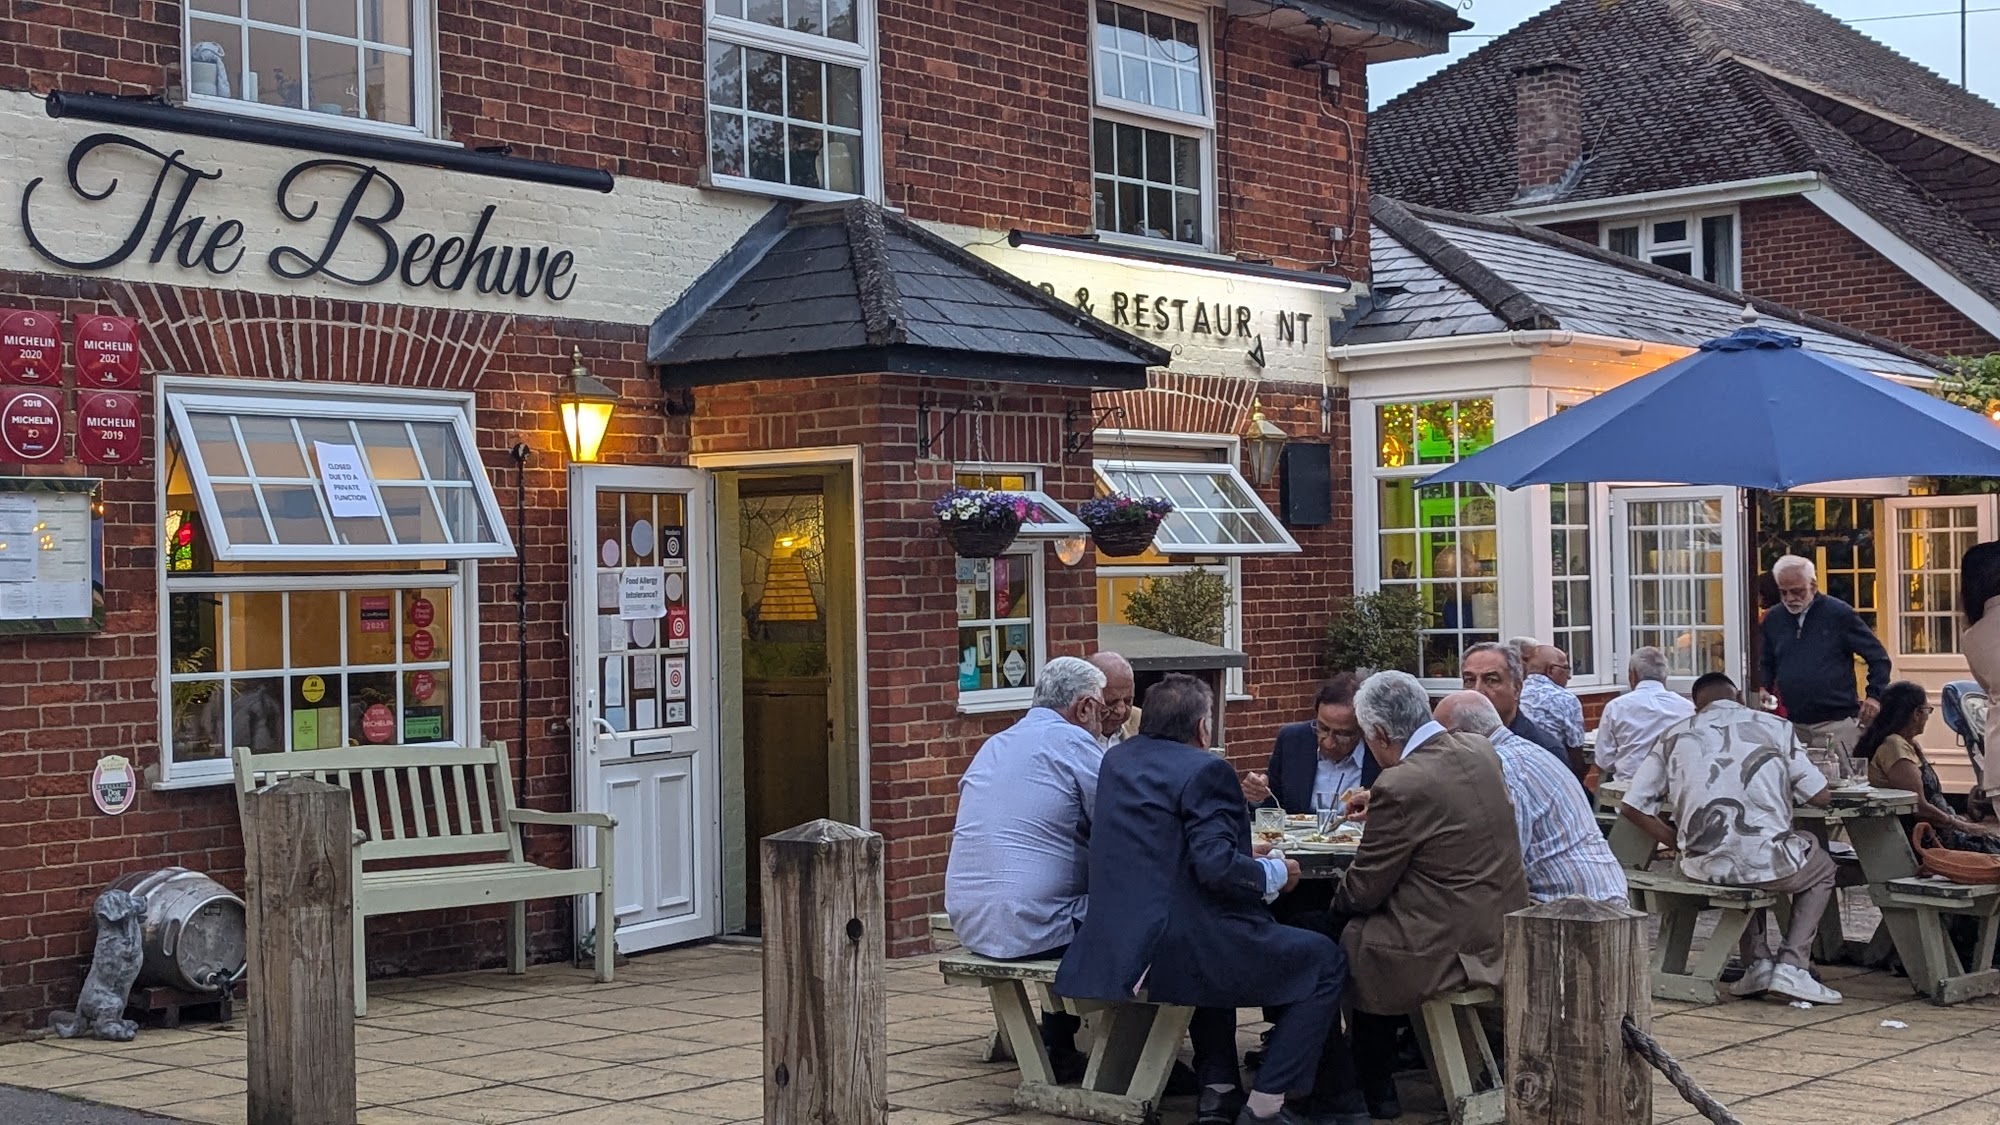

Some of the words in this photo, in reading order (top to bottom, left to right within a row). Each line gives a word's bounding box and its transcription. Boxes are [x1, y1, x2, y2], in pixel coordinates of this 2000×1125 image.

[21, 132, 246, 275] The
[4, 335, 56, 348] MICHELIN
[84, 340, 133, 352] MICHELIN
[20, 349, 43, 360] 2020
[100, 353, 121, 364] 2021
[23, 399, 42, 408] 2018
[11, 415, 54, 425] MICHELIN
[86, 416, 136, 428] MICHELIN
[101, 430, 124, 440] 2019
[625, 577, 639, 585] Food
[639, 576, 658, 586] Allergy
[625, 591, 658, 599] Intolerance?
